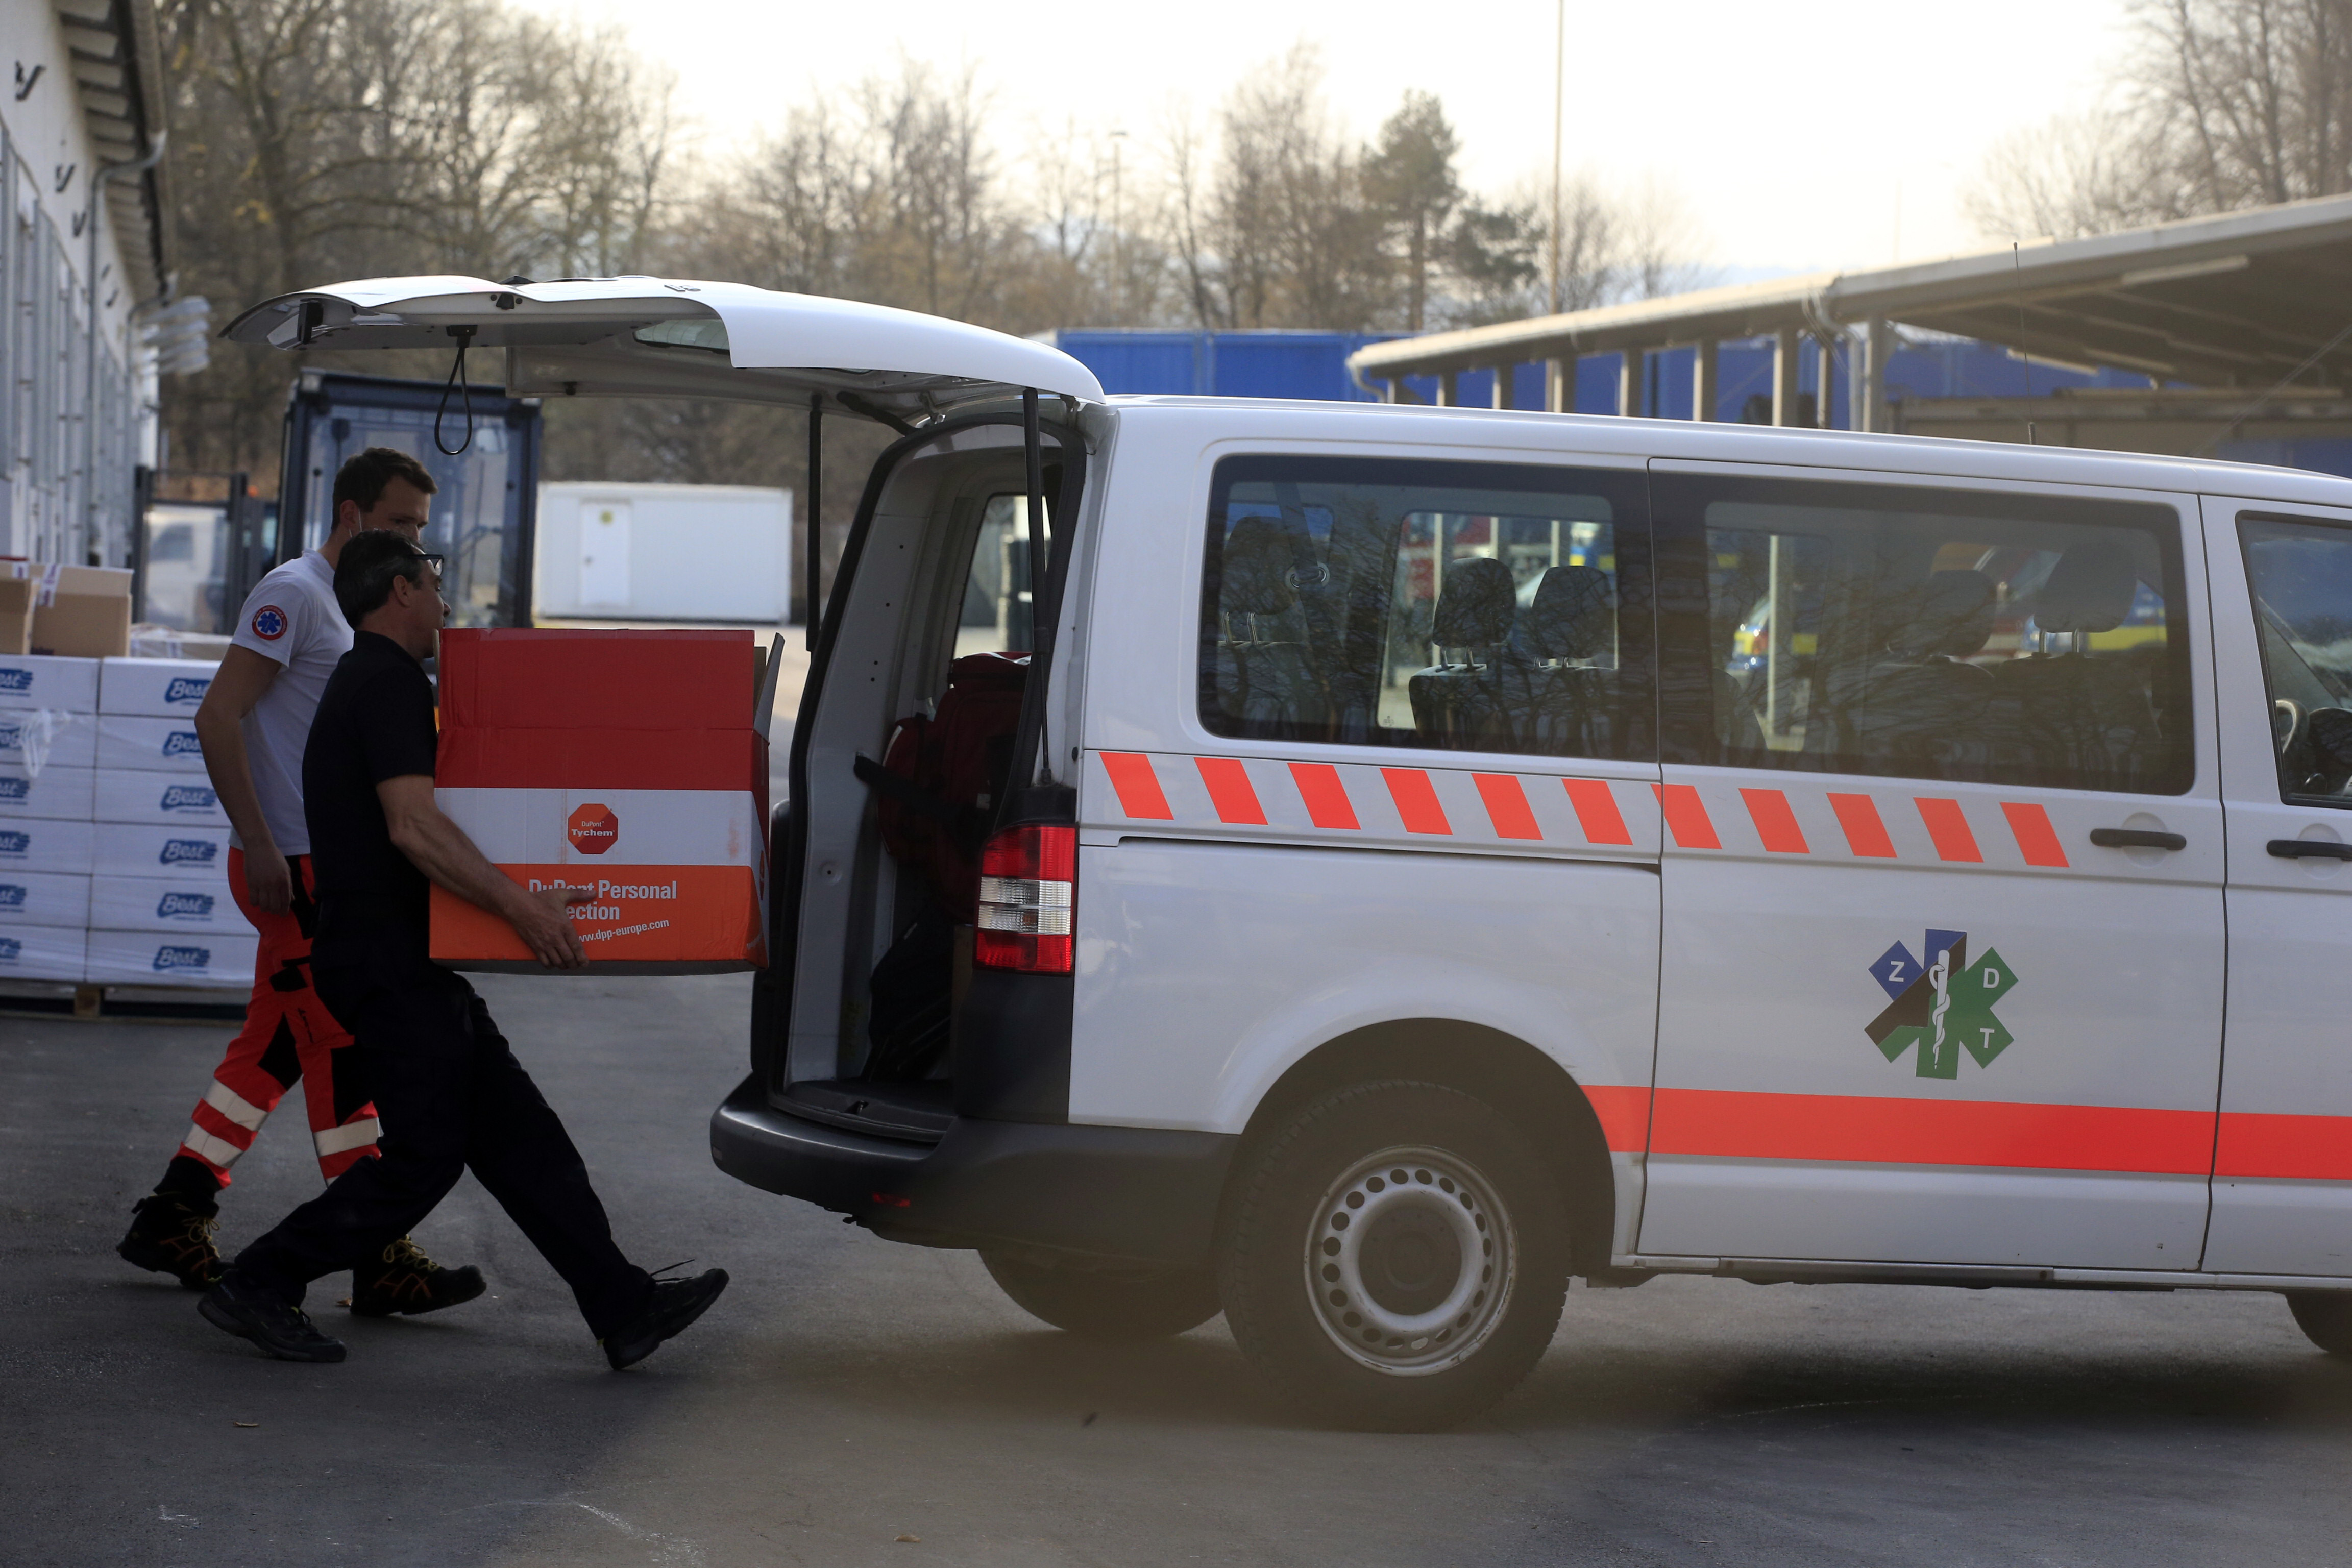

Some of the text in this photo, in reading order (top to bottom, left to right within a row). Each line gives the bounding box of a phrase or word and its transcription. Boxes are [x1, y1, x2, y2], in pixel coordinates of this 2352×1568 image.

[168, 734, 201, 751] Bes
[166, 788, 206, 805] Best
[165, 843, 206, 860] Best
[598, 880, 677, 899] Personal
[162, 895, 203, 913] Best
[565, 901, 620, 920] ection
[158, 948, 199, 965] Best
[1889, 961, 1904, 982] Z
[1983, 968, 1999, 988] D
[1980, 1028, 1995, 1048] T
